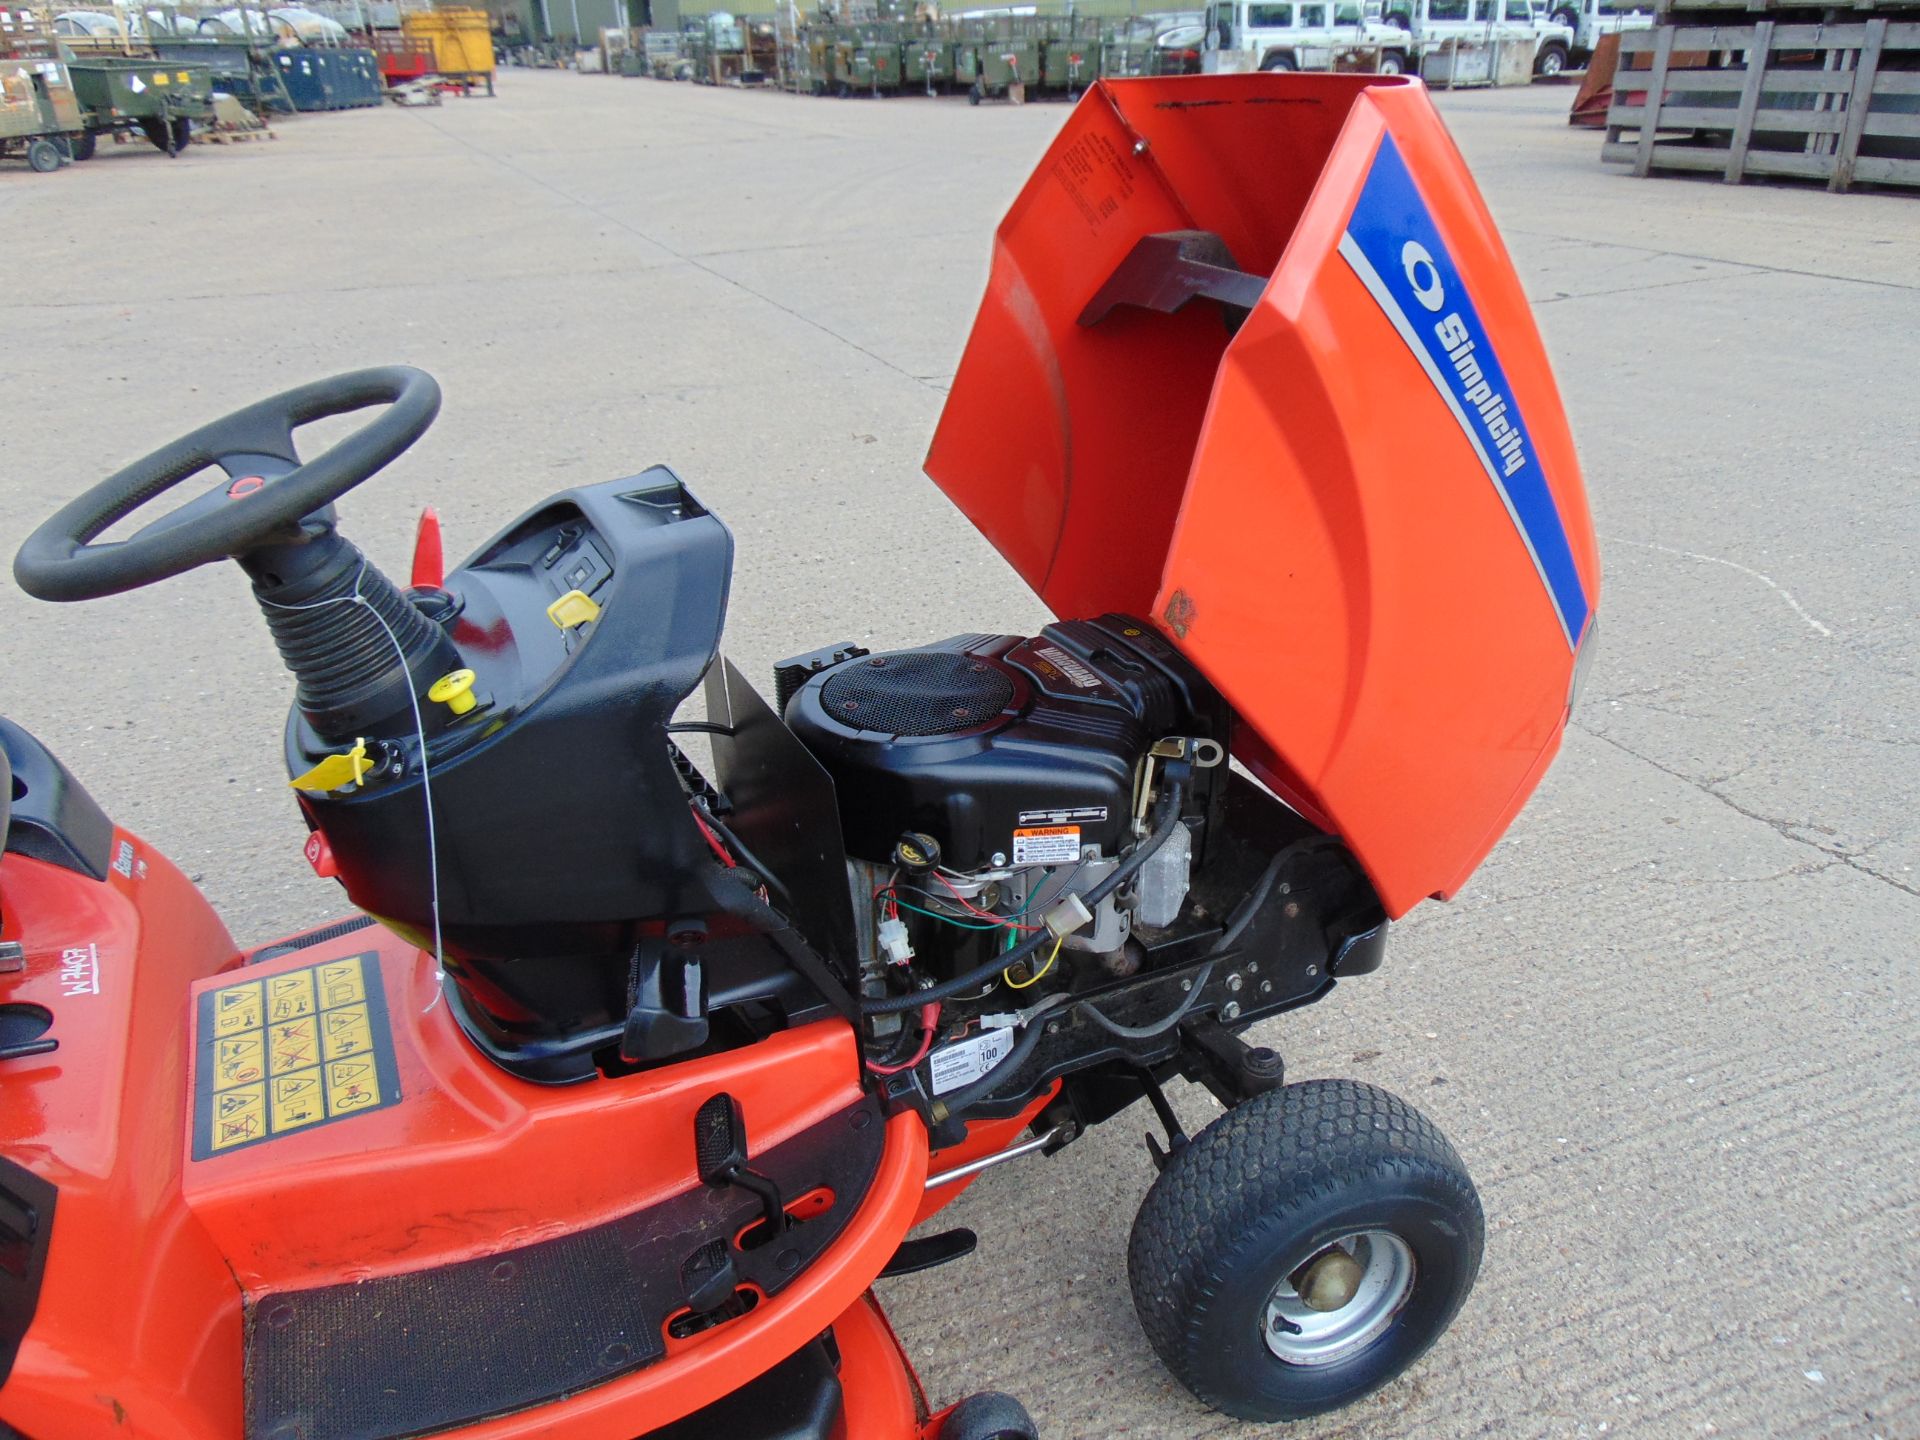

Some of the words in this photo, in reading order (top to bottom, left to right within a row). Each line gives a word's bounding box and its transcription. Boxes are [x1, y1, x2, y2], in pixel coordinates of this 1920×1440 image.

[1434, 312, 1527, 478] Simplicity
[1037, 646, 1103, 688] VANGUARD
[1031, 827, 1069, 836] WARNING
[112, 840, 135, 880] Baron
[980, 1047, 998, 1062] 100
